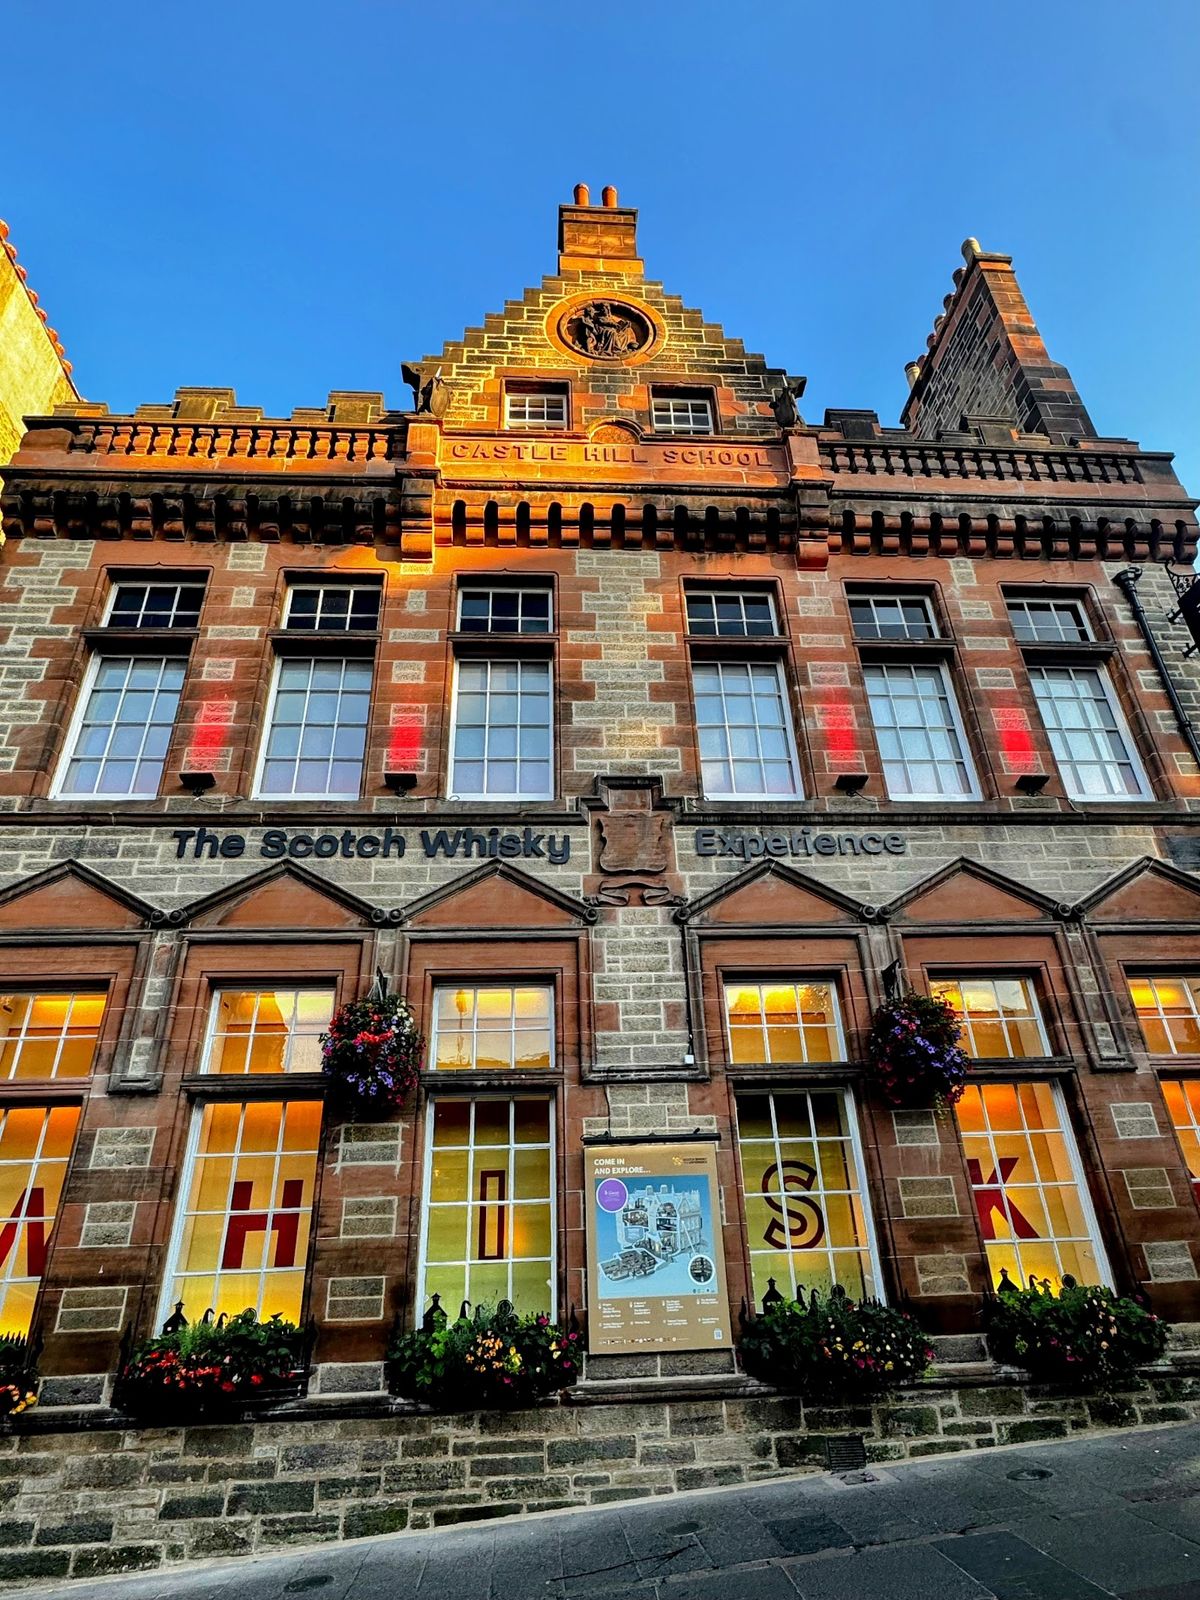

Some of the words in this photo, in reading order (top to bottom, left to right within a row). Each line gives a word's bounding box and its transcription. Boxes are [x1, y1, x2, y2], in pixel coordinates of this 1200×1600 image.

[452, 443, 567, 461] CASTLE
[583, 446, 648, 463] HILL
[663, 449, 773, 466] SCHOOL
[173, 828, 246, 858] The
[260, 828, 405, 858] Scotch
[420, 827, 571, 865] Whisky
[695, 827, 907, 862] Experience
[594, 1158, 616, 1166] COME
[594, 1167, 611, 1175] AND
